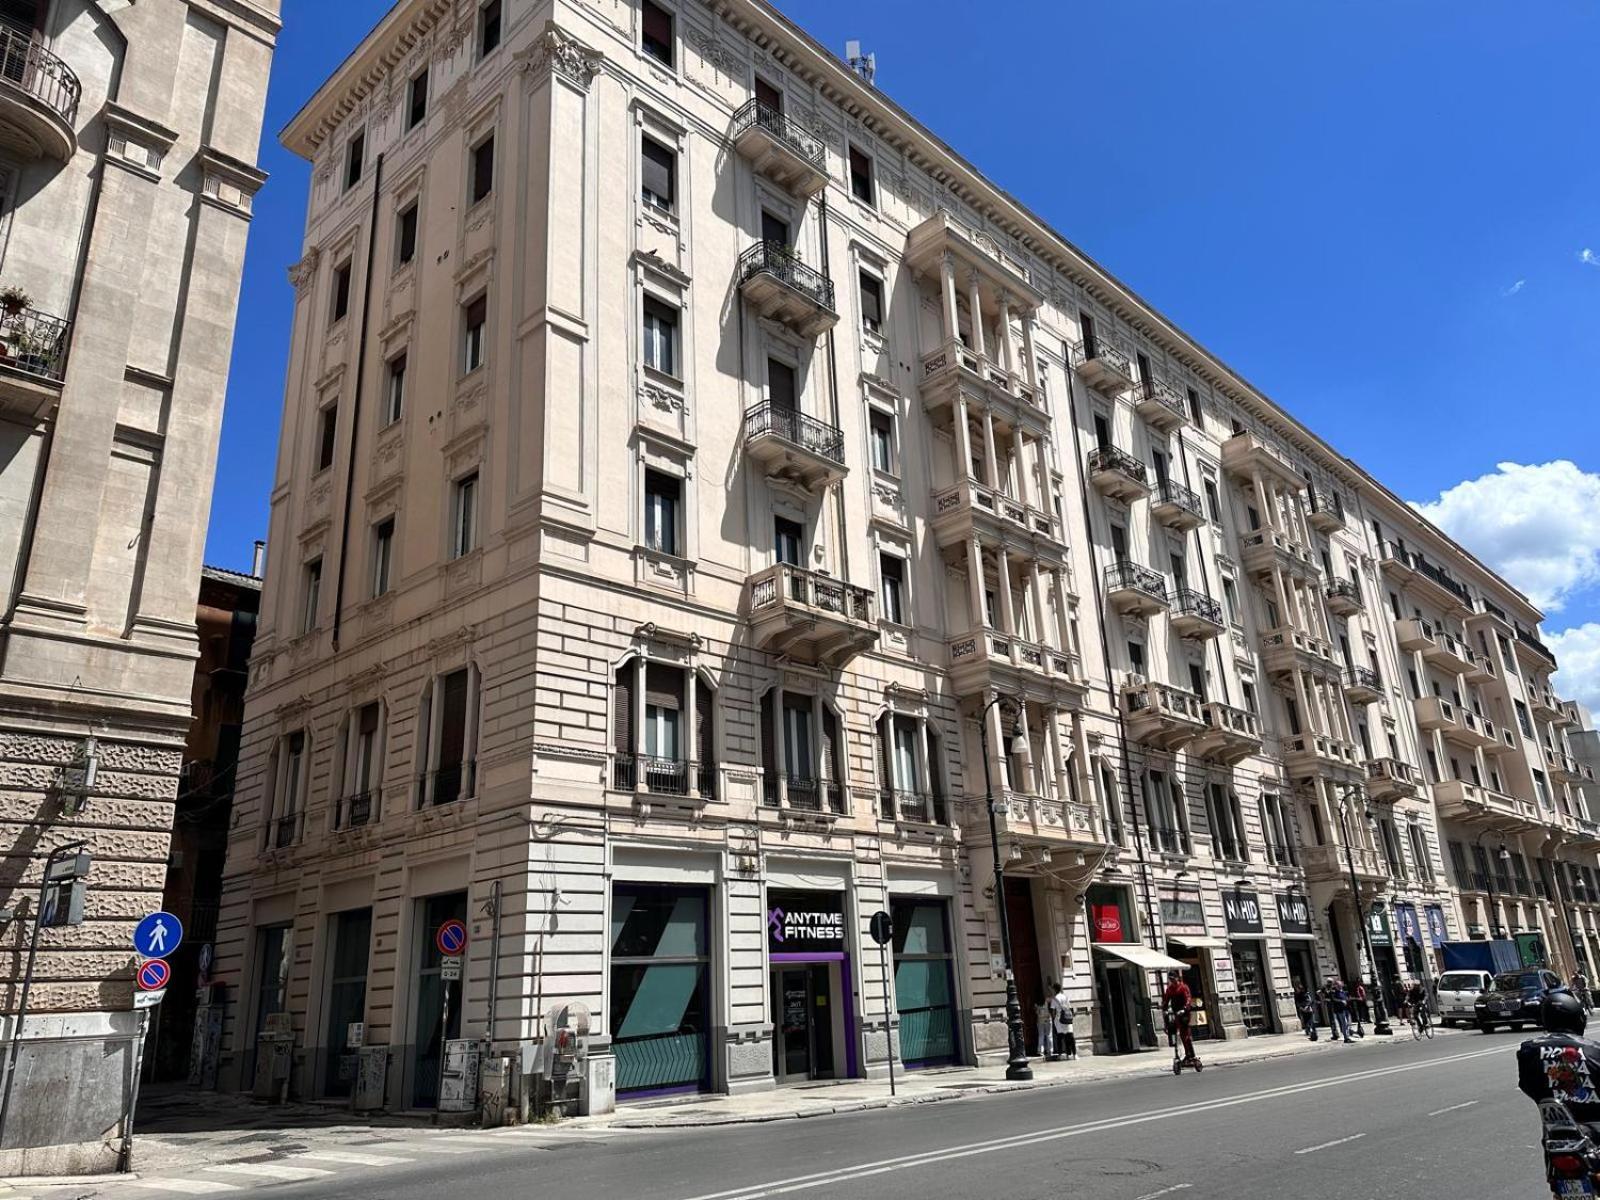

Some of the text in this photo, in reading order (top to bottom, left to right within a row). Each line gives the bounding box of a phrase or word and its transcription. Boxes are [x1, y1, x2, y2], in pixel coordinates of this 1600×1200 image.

[1226, 900, 1258, 920] NAHID
[785, 912, 843, 925] ANYTIME
[785, 926, 844, 939] FITNESS
